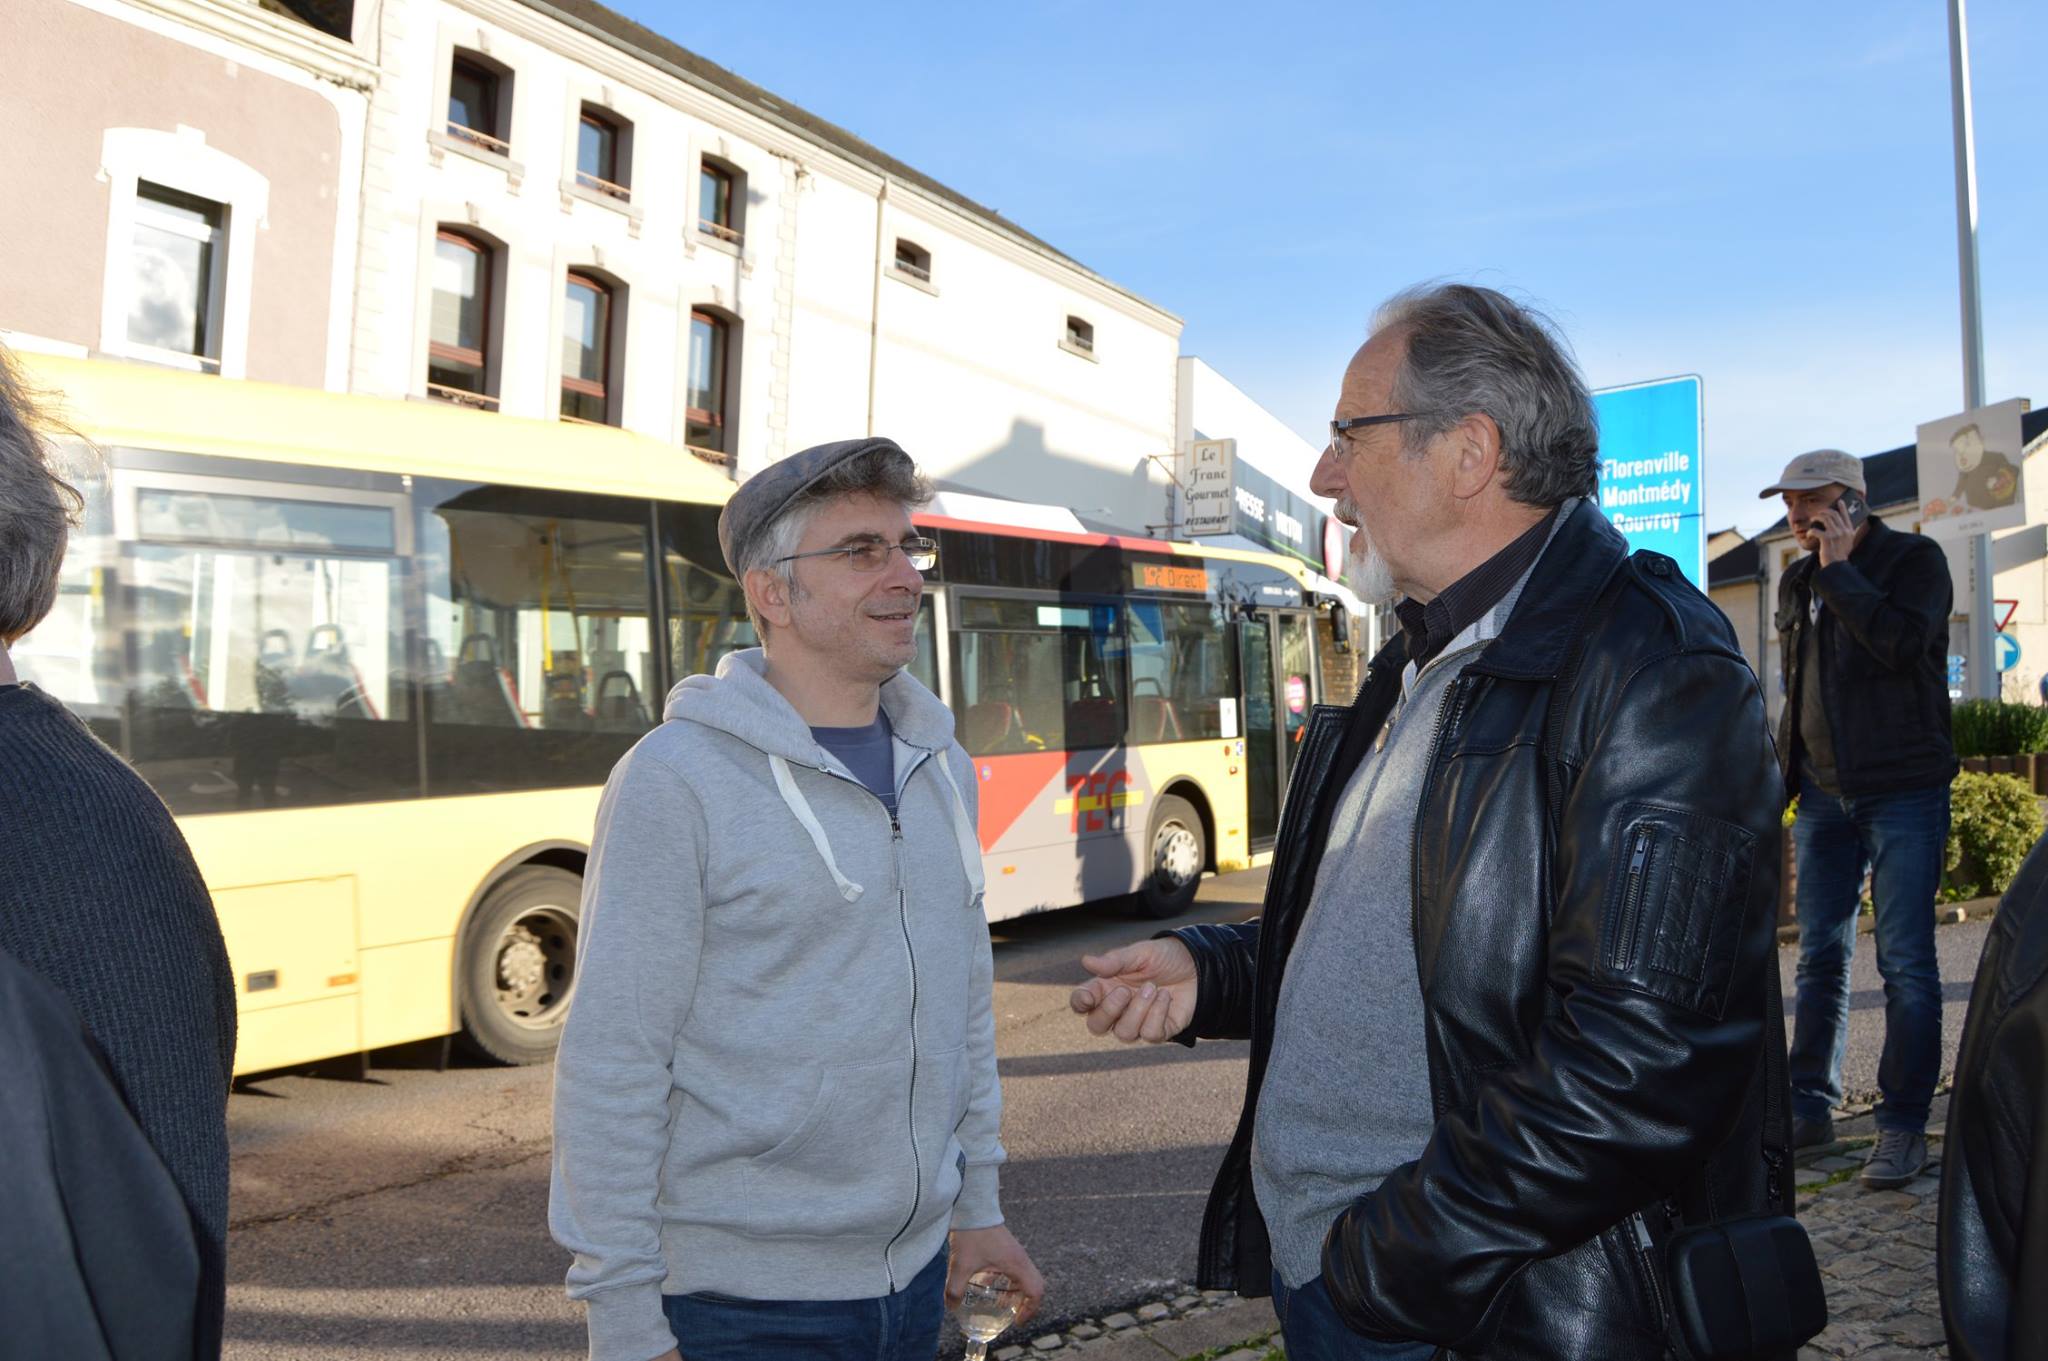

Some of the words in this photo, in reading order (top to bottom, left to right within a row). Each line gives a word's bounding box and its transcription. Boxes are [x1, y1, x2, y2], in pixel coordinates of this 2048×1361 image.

[1201, 447, 1216, 461] Le
[1602, 451, 1690, 480] Florenville
[1185, 487, 1229, 504] Gourmet
[1603, 478, 1692, 508] Montmédy
[1066, 770, 1133, 833] TEC
